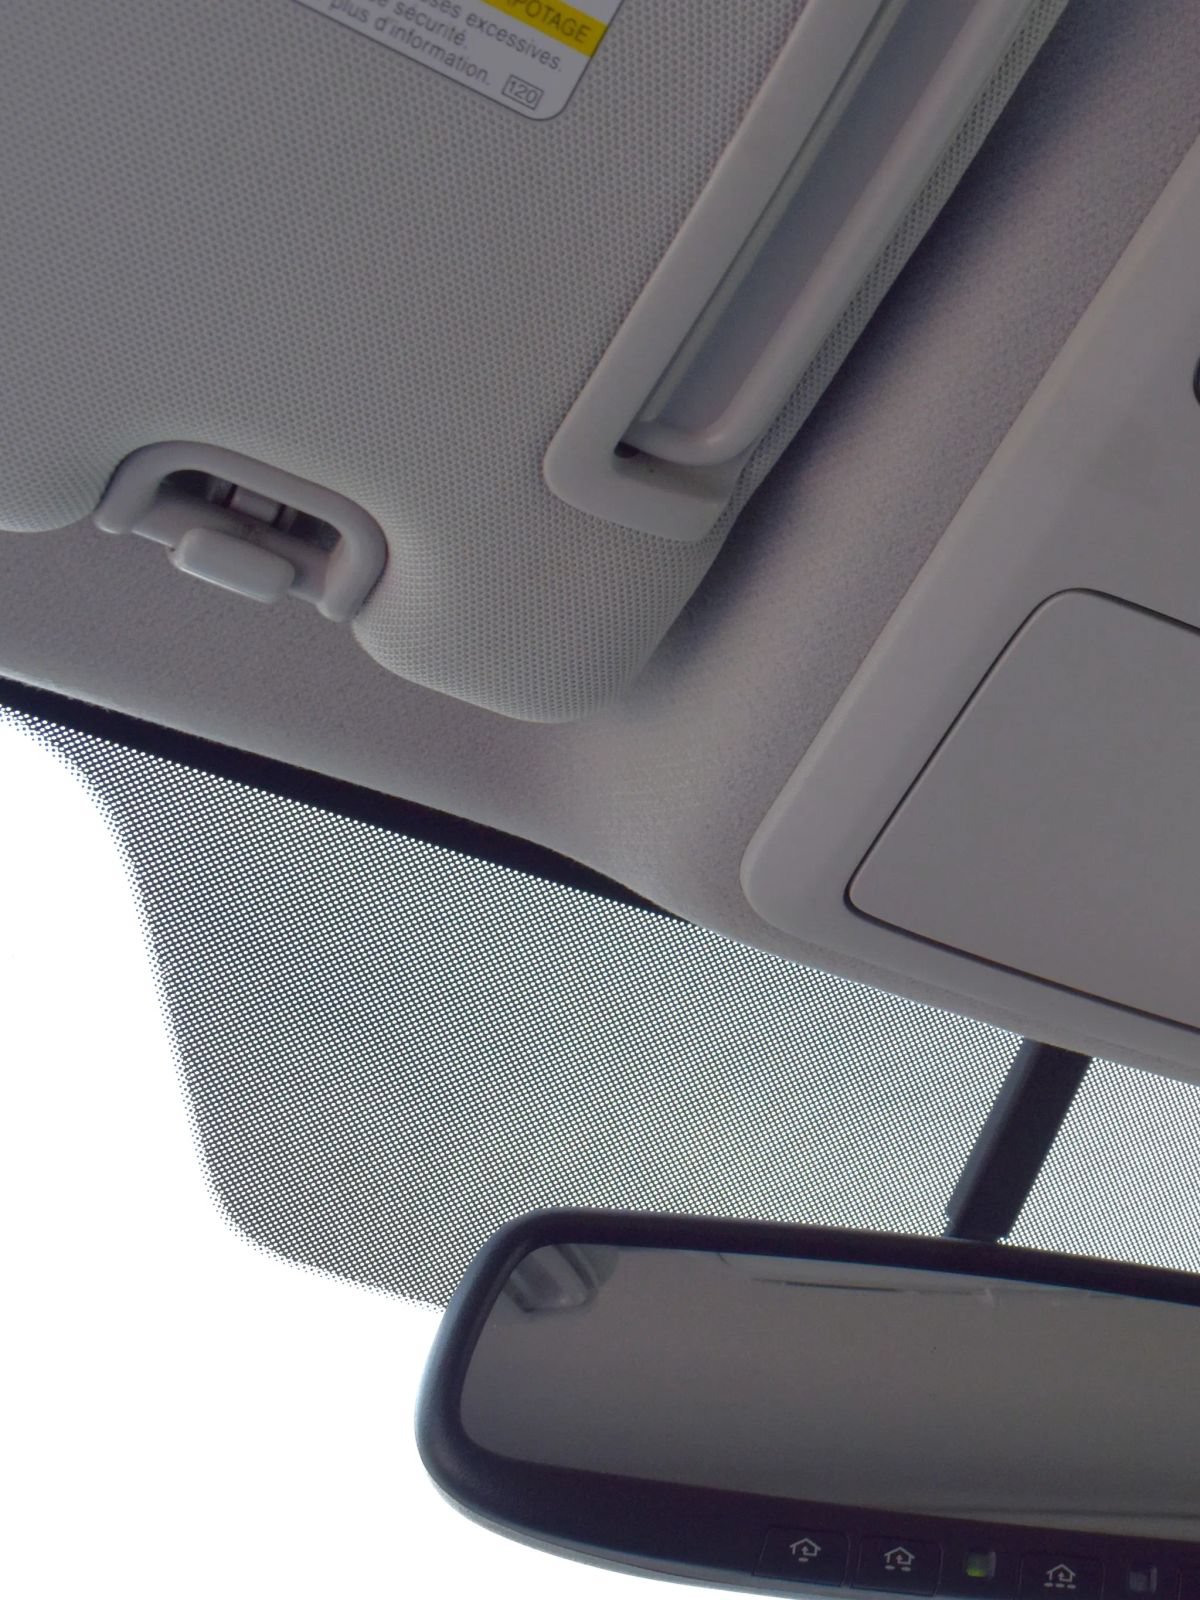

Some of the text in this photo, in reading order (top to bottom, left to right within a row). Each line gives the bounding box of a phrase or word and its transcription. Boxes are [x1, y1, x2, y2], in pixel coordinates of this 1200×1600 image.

[373, 16, 491, 86] d'information.
[393, 1, 468, 49] sécurité.
[466, 12, 562, 72] excessives.
[508, 79, 540, 105] 120
